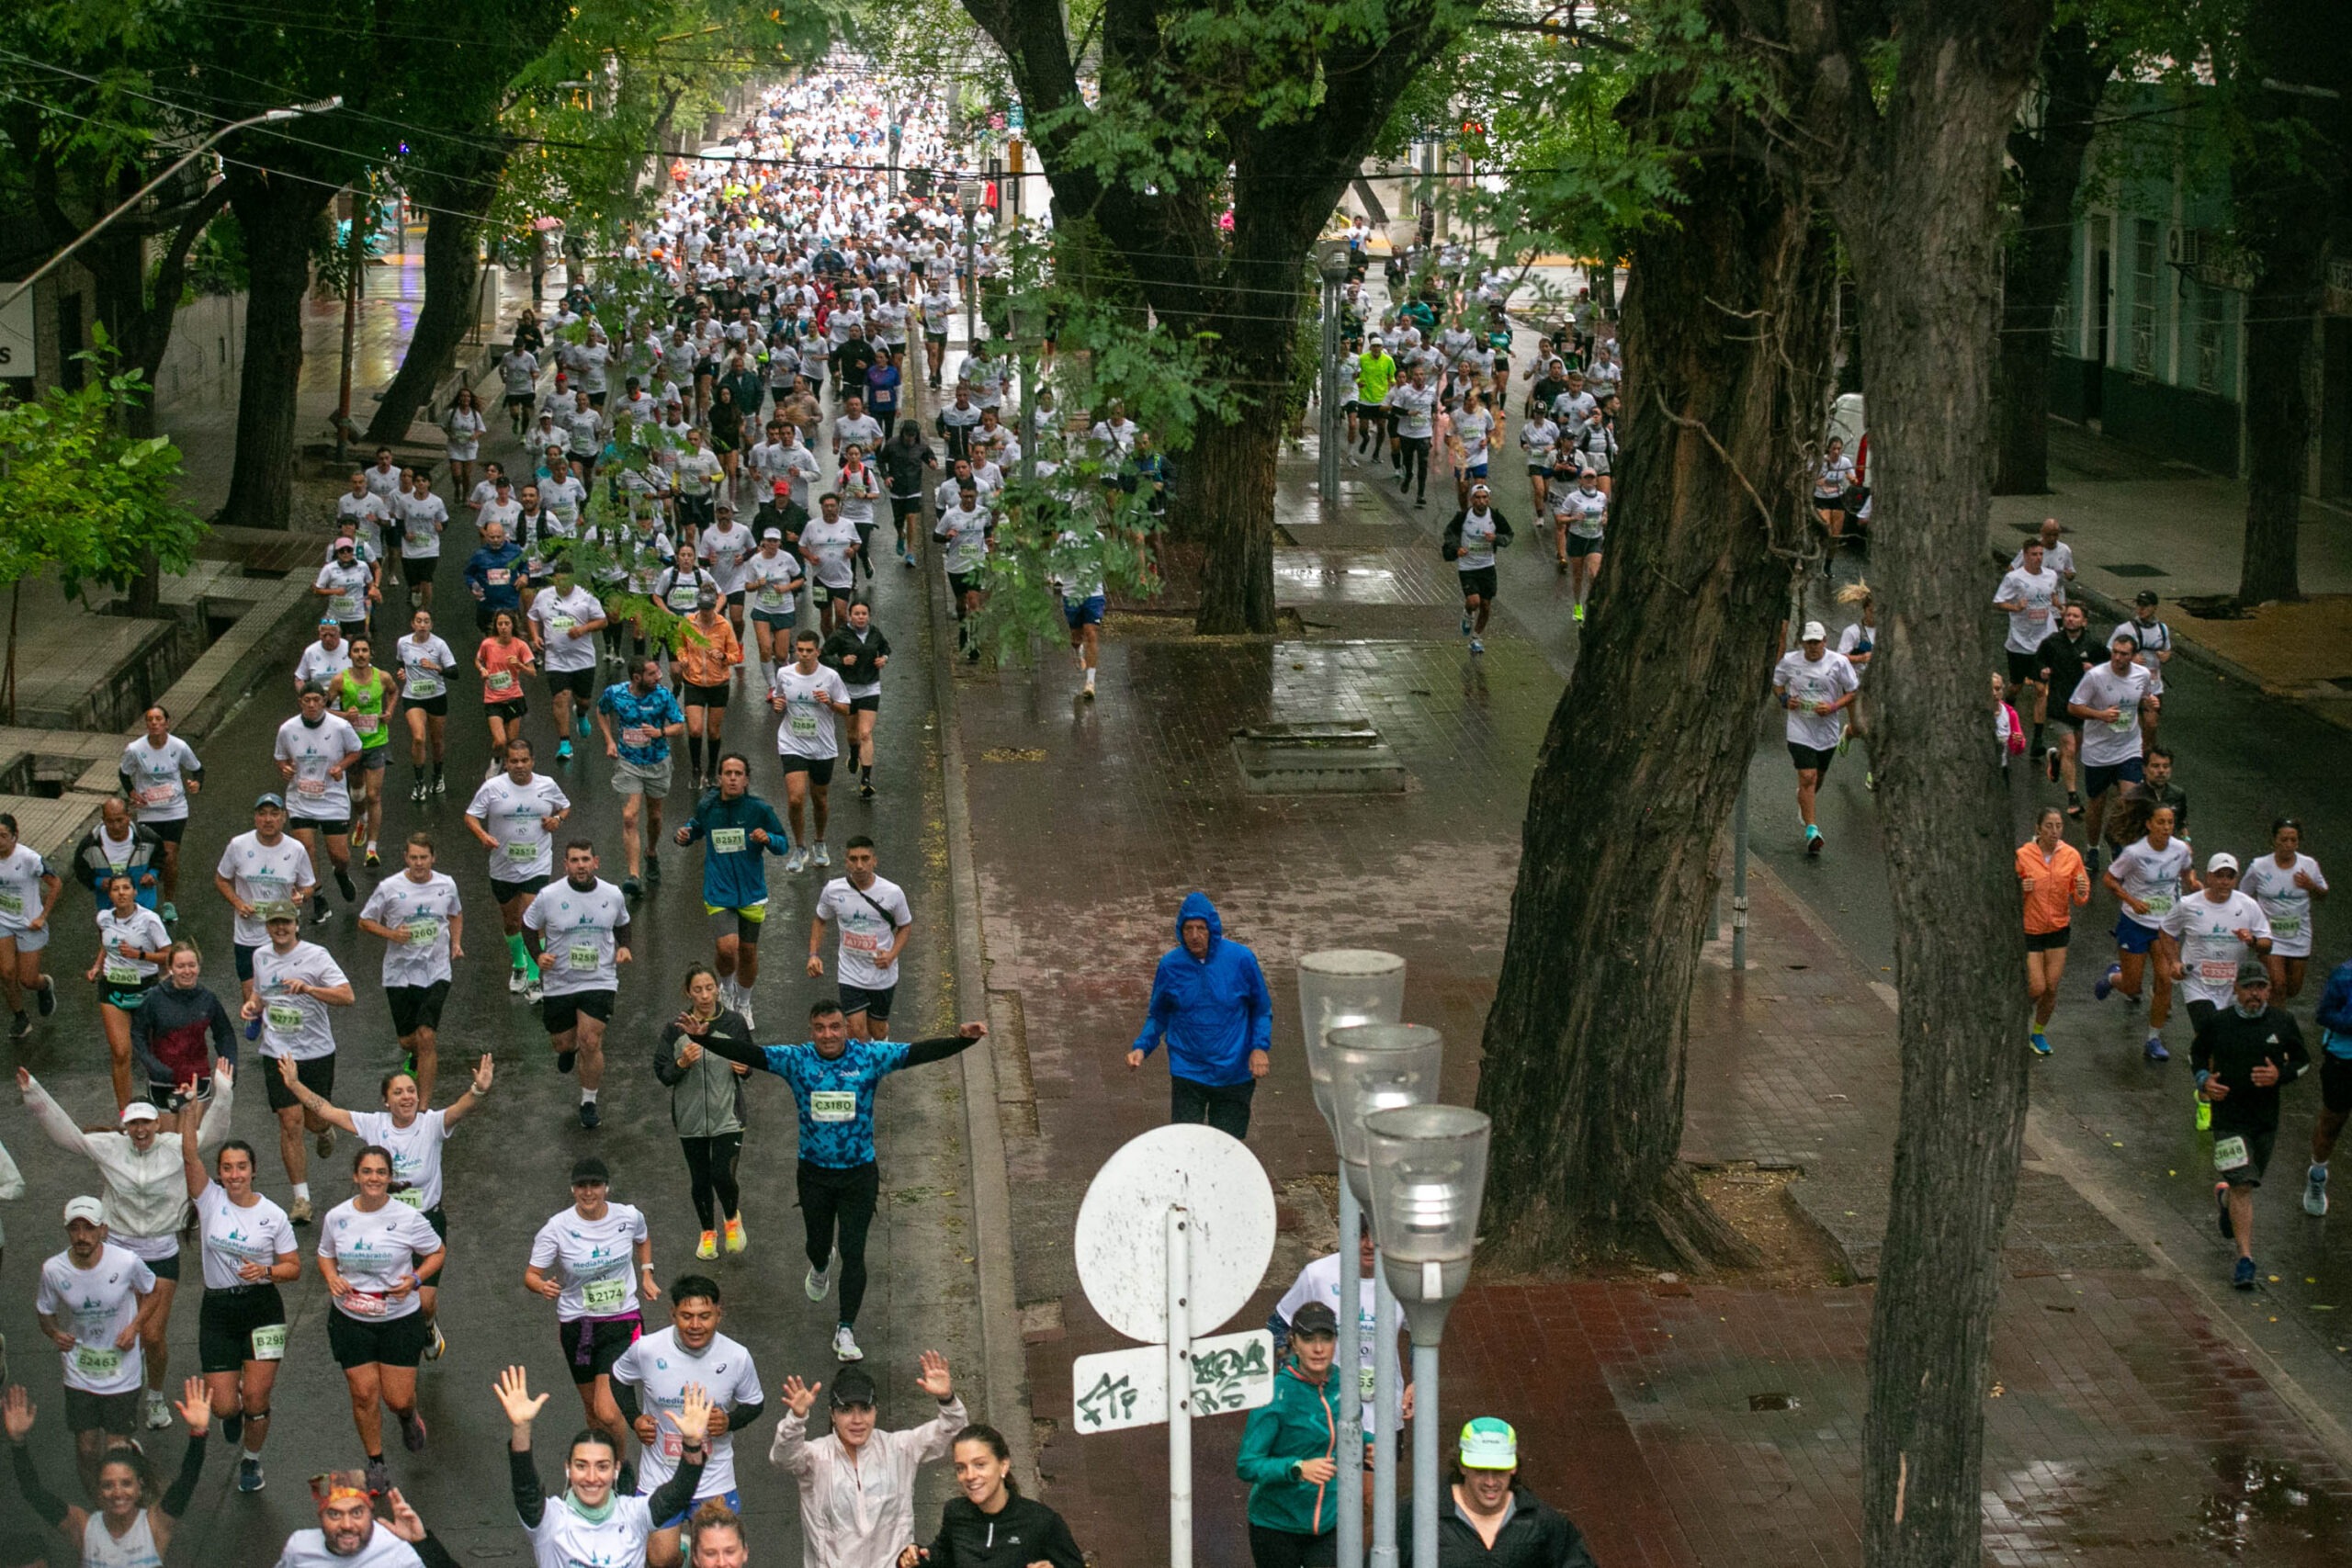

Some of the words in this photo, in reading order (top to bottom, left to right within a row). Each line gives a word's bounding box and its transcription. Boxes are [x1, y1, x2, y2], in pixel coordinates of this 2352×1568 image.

[716, 836, 741, 844] B2571
[815, 1100, 852, 1111] C3180
[588, 1289, 623, 1303] B2174
[256, 1335, 284, 1348] B295
[79, 1354, 119, 1368] B2463
